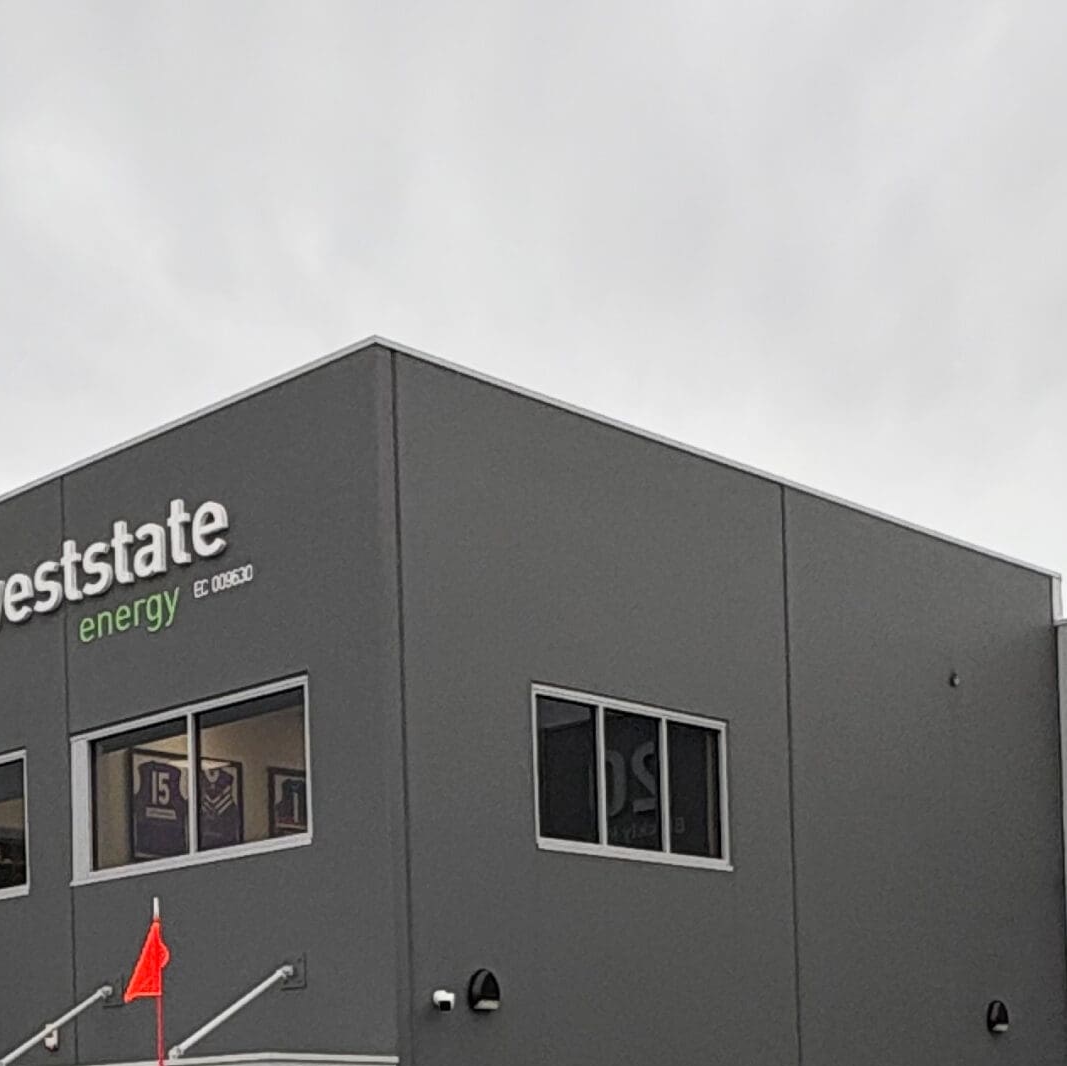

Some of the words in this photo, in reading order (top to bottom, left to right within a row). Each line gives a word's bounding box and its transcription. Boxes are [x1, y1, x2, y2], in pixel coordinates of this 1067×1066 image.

[193, 578, 209, 599] EC
[78, 586, 180, 643] energy
[151, 770, 171, 806] 15
